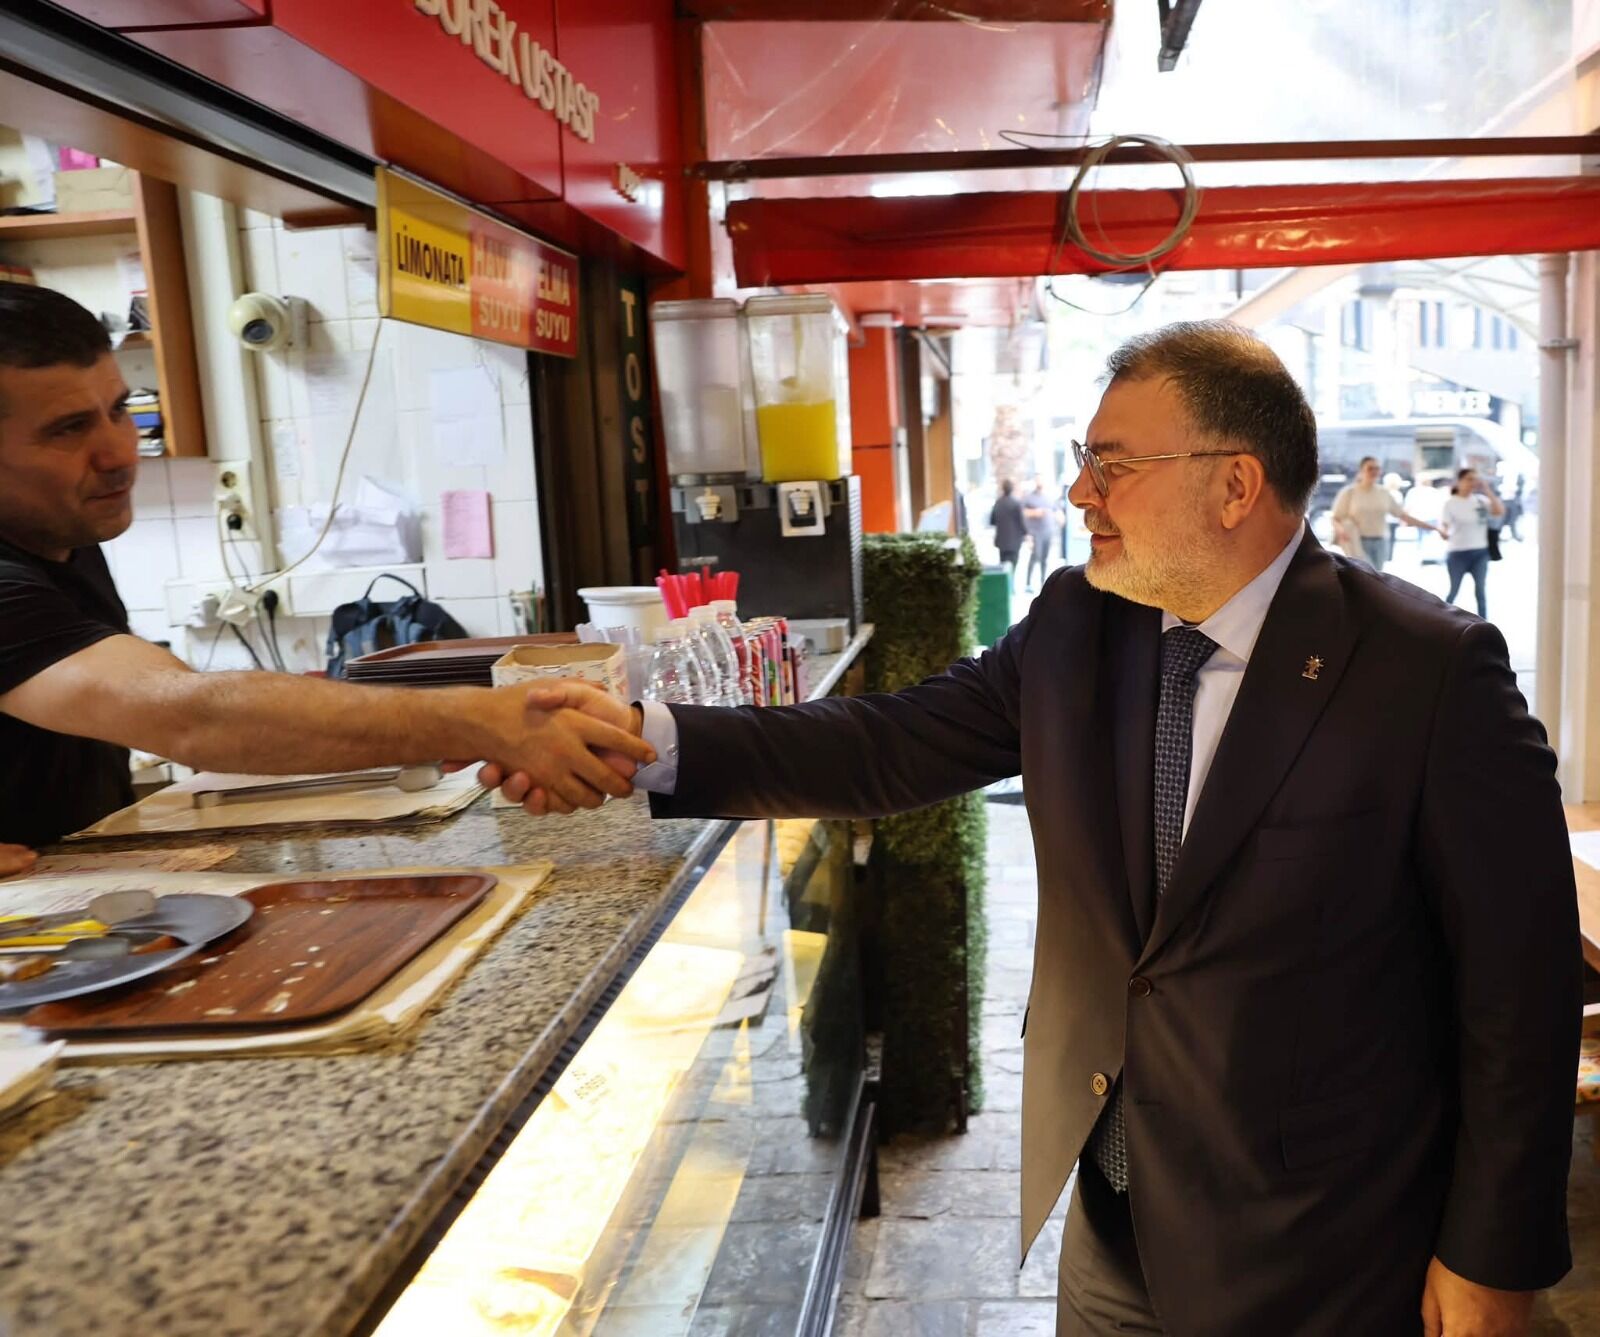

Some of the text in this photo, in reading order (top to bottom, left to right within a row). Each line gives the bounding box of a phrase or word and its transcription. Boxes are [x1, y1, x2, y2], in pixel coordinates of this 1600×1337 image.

[414, 0, 520, 85] REK
[537, 260, 571, 307] ELMA
[479, 295, 522, 334] SUYU
[535, 308, 571, 343] SUYU
[620, 288, 649, 526] TOST
